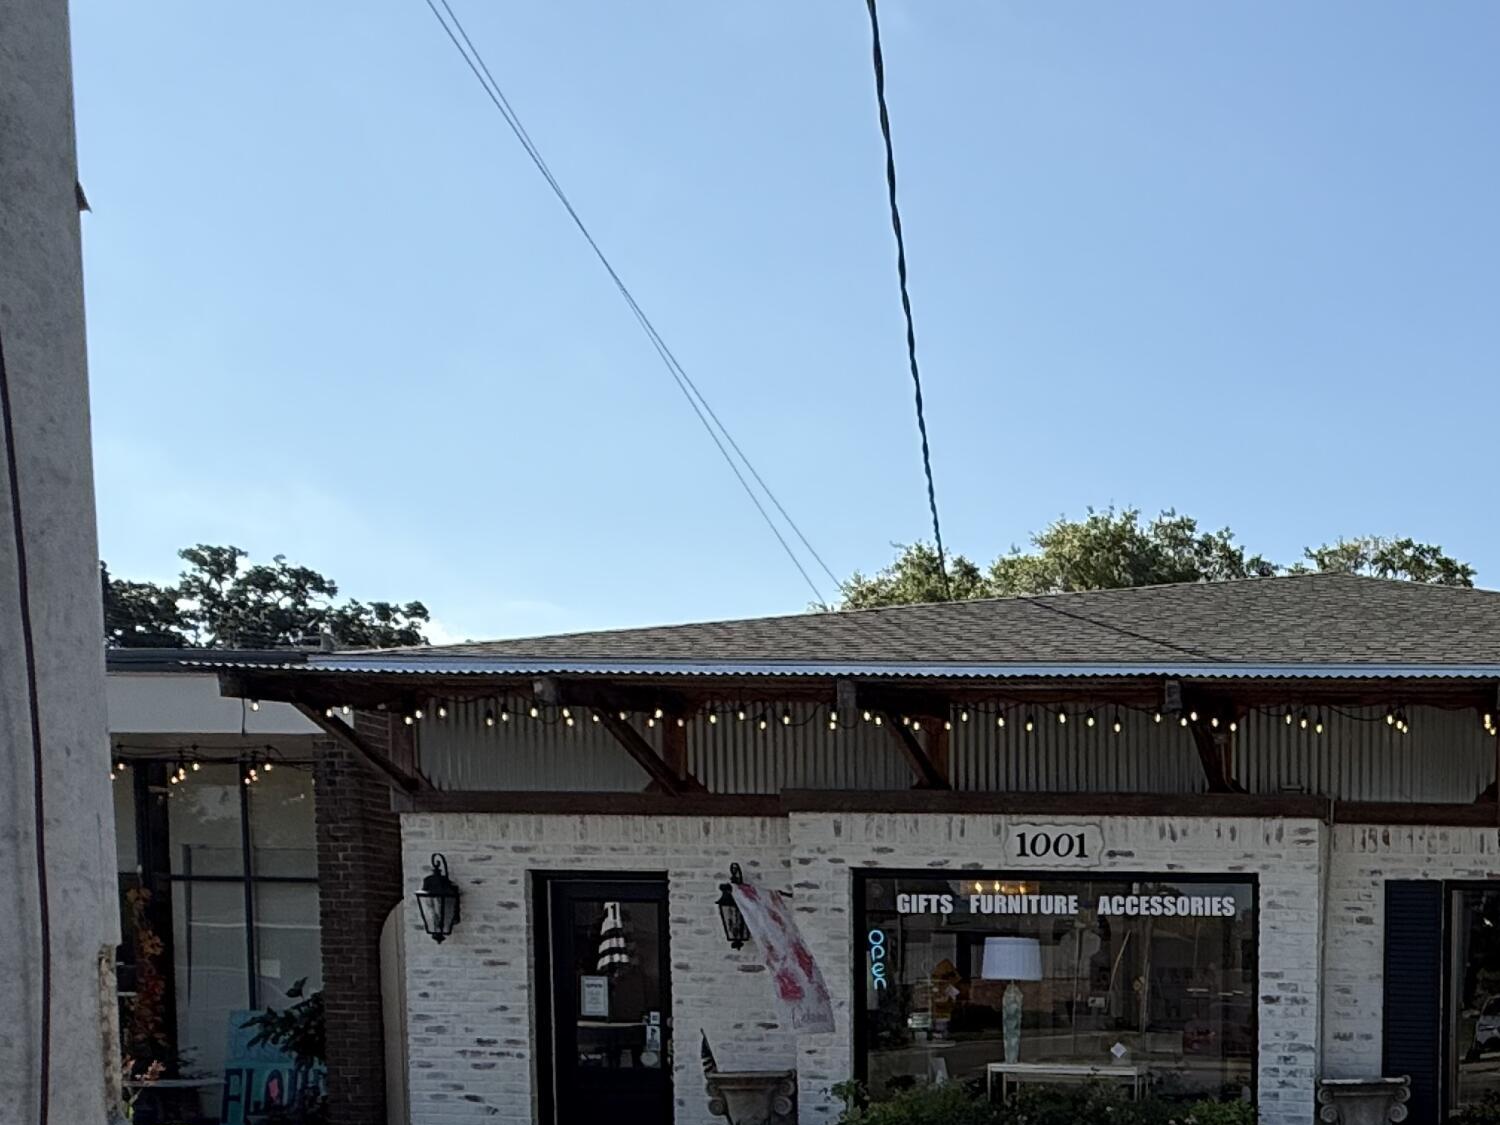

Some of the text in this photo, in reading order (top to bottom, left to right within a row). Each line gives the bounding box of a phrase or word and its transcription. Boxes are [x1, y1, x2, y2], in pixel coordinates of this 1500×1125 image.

[1016, 832, 1088, 858] 1001
[896, 894, 1235, 917] GIFTS FURNITURE ACCESSORIES
